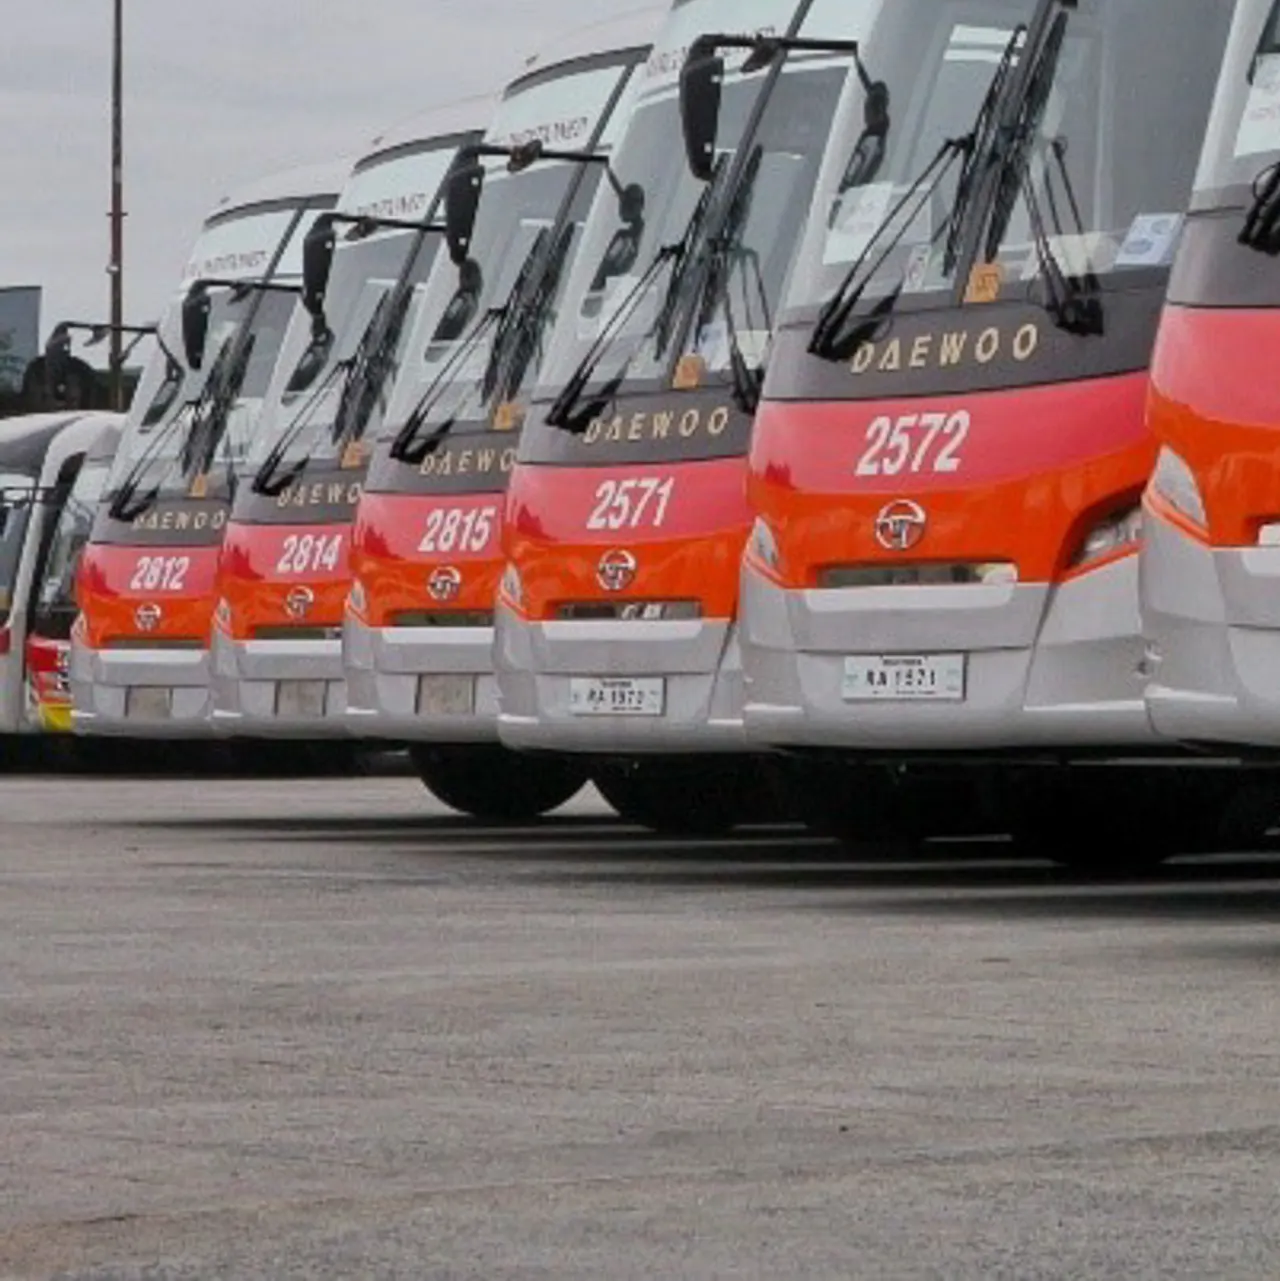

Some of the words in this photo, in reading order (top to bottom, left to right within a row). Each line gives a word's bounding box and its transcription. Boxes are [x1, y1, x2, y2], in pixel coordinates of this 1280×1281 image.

[850, 323, 1039, 374] DAEWOO
[583, 406, 729, 444] DAEWOO
[854, 409, 971, 477] 2572
[420, 448, 518, 476] DAEWO
[276, 482, 362, 508] DAEWO
[585, 476, 675, 530] 2571
[418, 506, 496, 553] 2815
[130, 556, 190, 590] 2812
[277, 534, 342, 574] 2814
